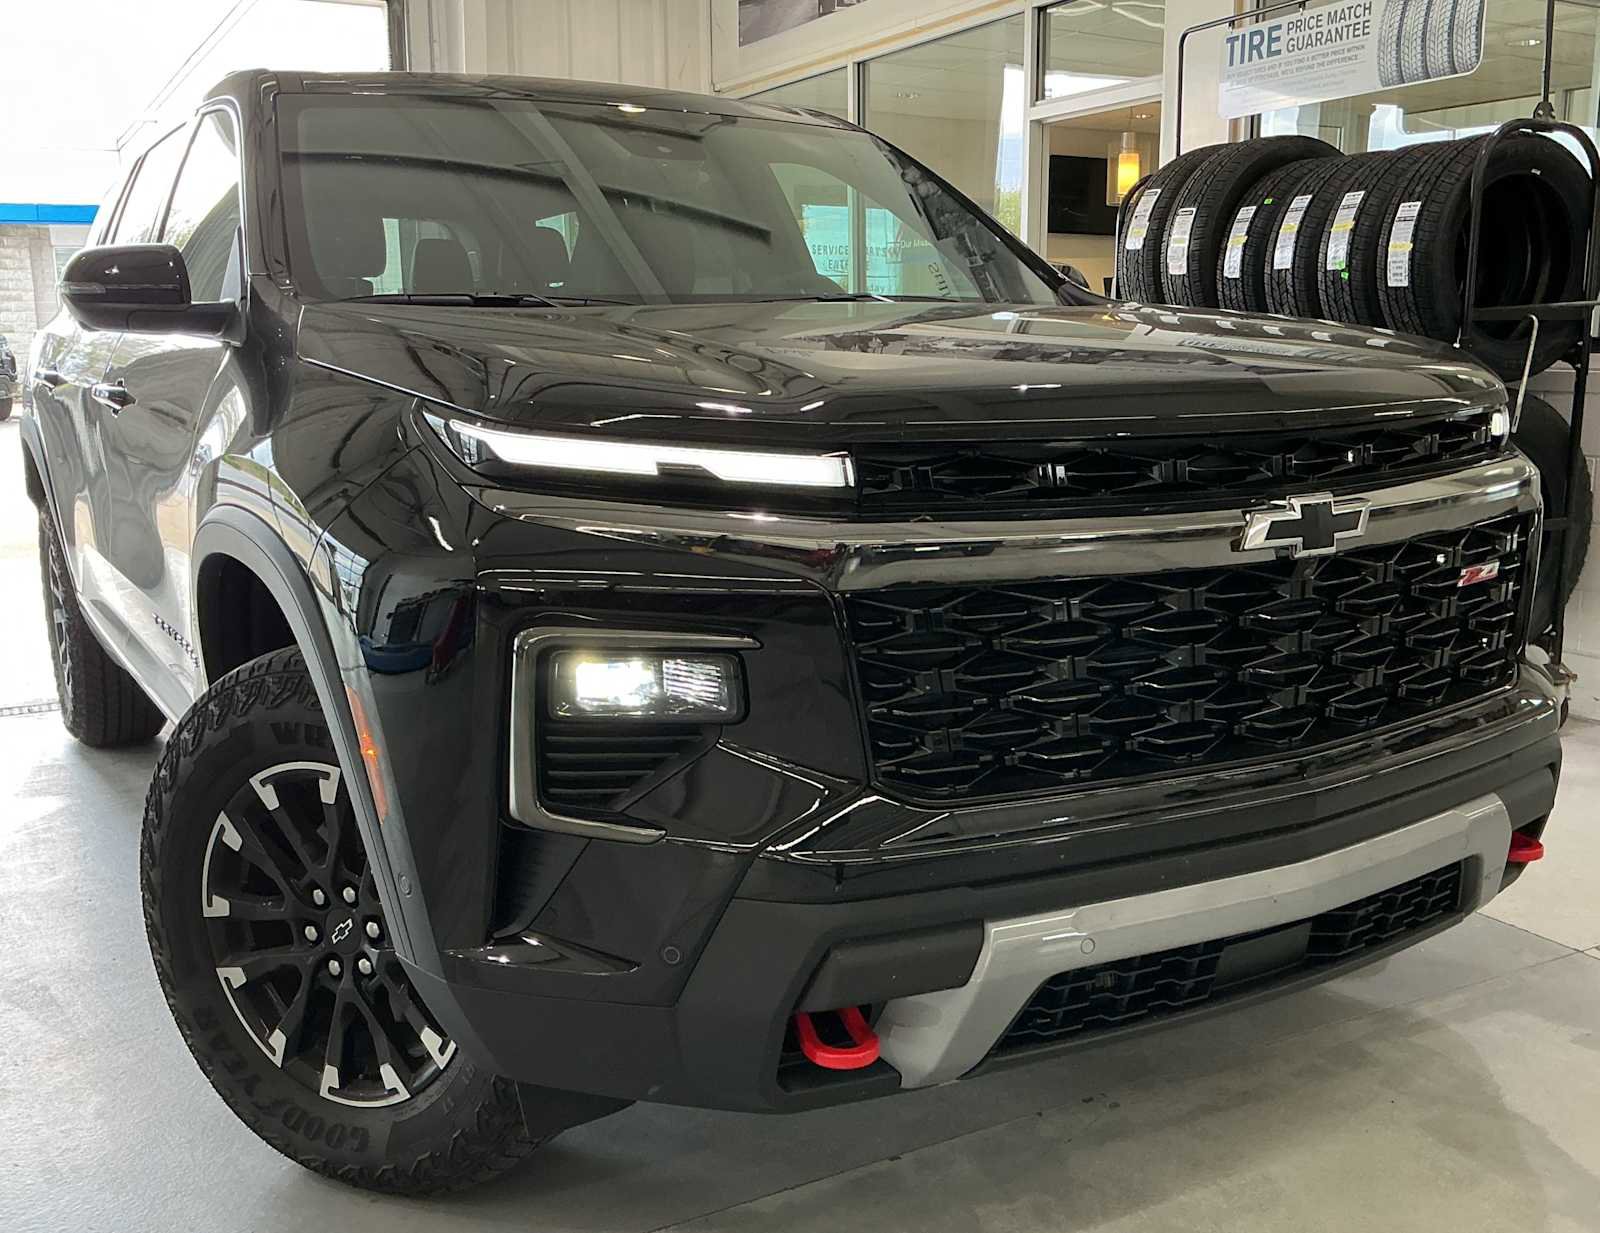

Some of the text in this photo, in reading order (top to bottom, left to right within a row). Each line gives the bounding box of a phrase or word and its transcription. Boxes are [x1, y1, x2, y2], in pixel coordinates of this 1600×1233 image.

[1286, 1, 1372, 36] PRICE MATCH
[1226, 24, 1282, 67] TIRE
[1286, 19, 1371, 54] GUARANTEE
[812, 243, 849, 256] SERVICE
